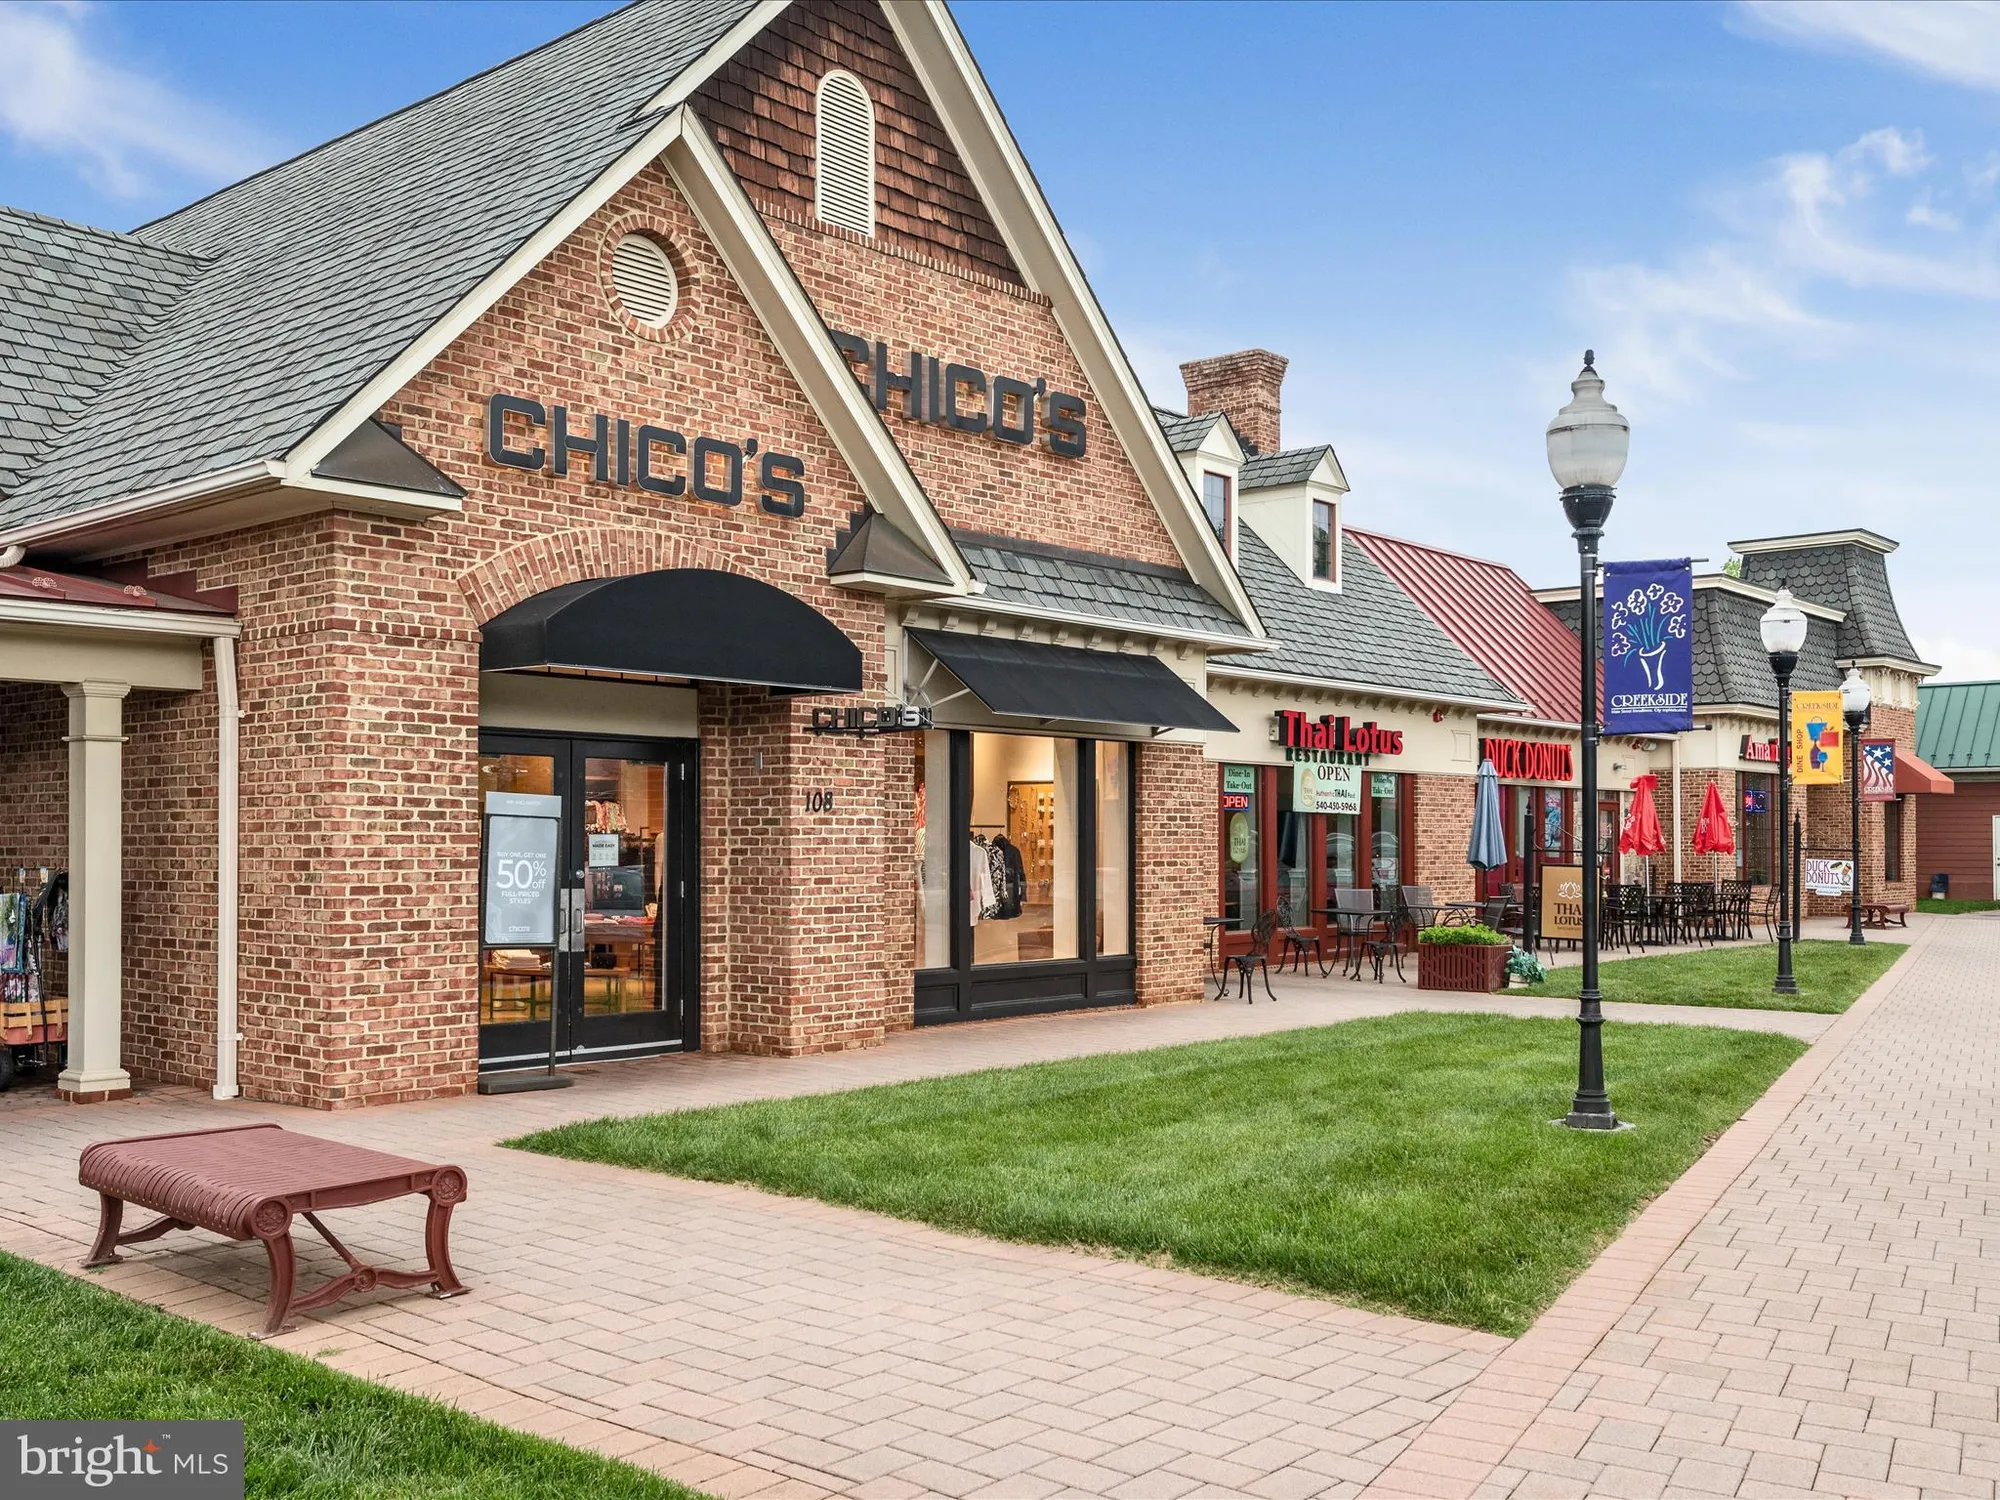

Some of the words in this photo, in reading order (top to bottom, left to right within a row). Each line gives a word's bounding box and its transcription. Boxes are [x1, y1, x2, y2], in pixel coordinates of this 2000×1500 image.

[488, 393, 805, 518] CHICO'S
[1611, 693, 1688, 707] CREEKSIDE
[812, 704, 920, 728] CHICO'S
[1281, 710, 1335, 750] Thai
[1342, 716, 1403, 755] Lotus
[1286, 748, 1371, 766] RESTAURANT
[1484, 737, 1523, 778] DUCK
[1525, 741, 1573, 781] DONUTS
[1228, 769, 1251, 778] Dine-In
[1317, 766, 1351, 781] OPEN
[1226, 781, 1252, 789] Take-Out
[1334, 789, 1347, 798] THAI
[805, 791, 833, 813] 108
[1224, 796, 1248, 808] OPEN
[1806, 860, 1830, 872] DUCK
[496, 859, 546, 889] 50%
[532, 879, 546, 888] off
[1806, 872, 1840, 884] DONUTS
[1554, 903, 1582, 915] THA
